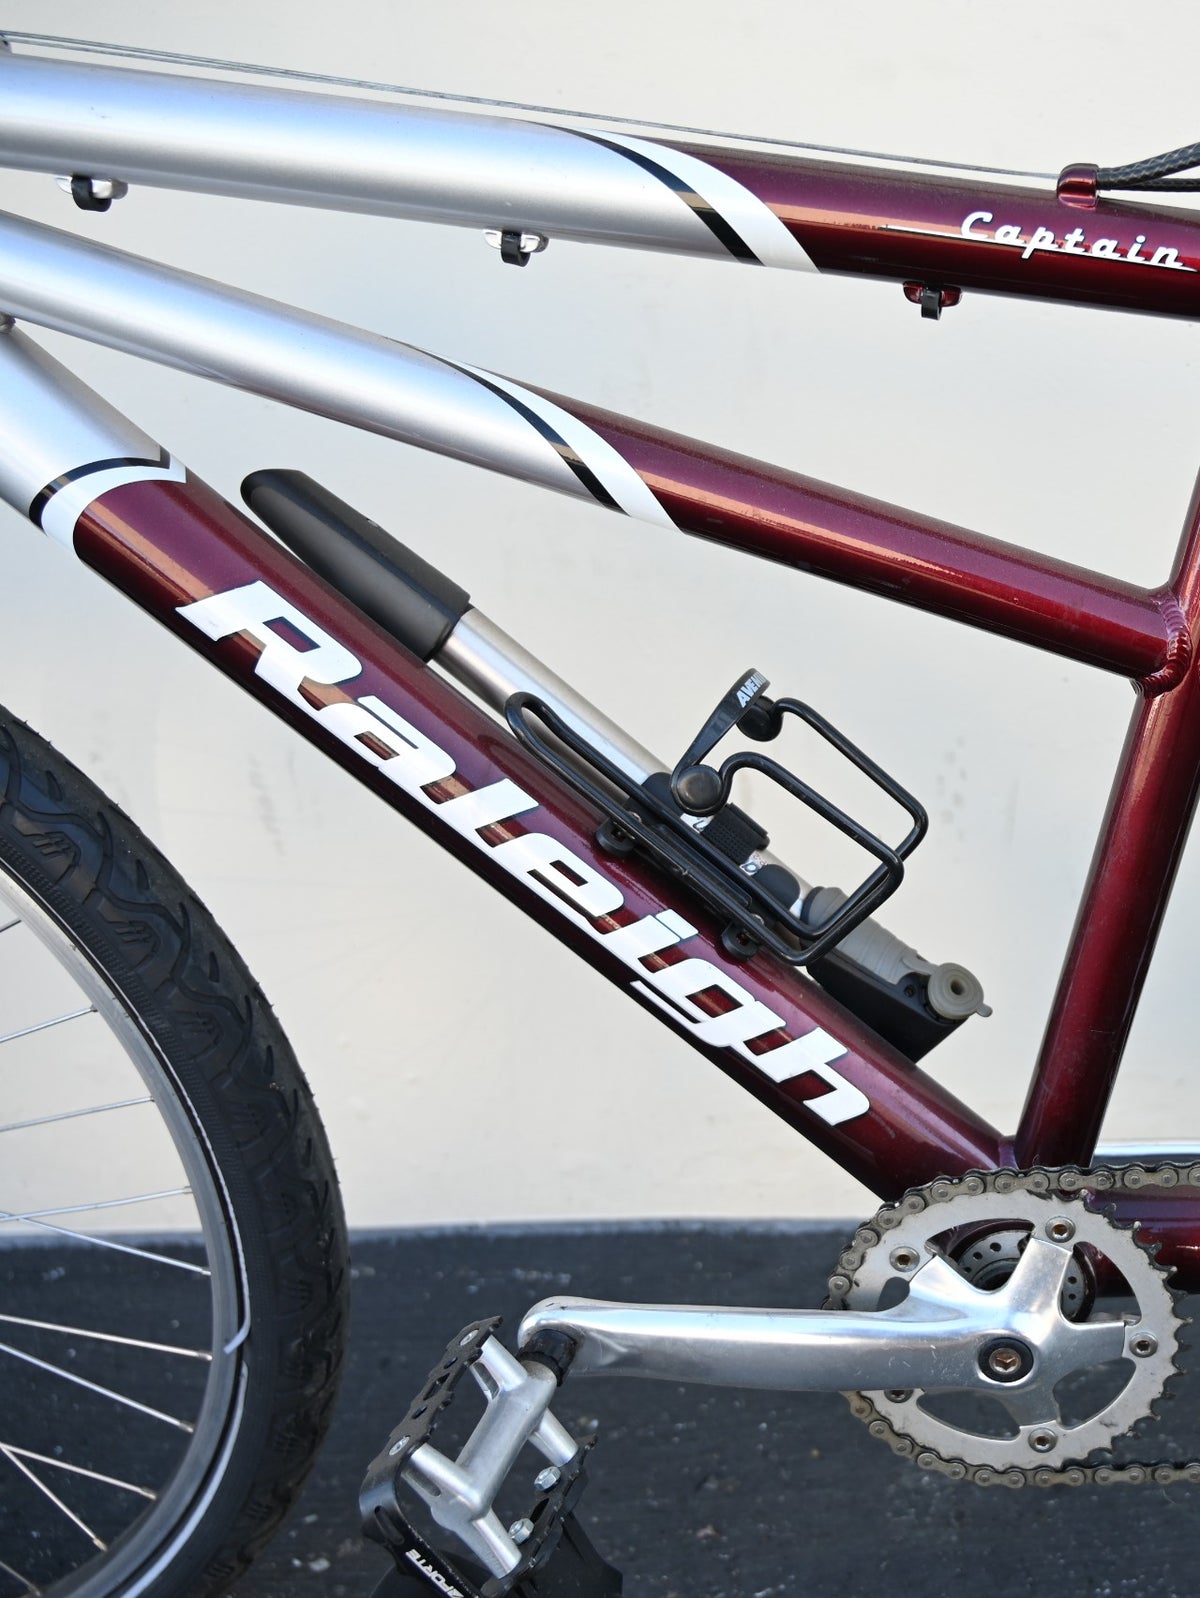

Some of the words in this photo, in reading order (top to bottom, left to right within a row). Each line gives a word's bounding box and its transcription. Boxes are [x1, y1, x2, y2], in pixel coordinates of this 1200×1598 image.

[960, 211, 1184, 268] Captain
[175, 580, 869, 1126] Raleigh
[405, 1549, 455, 1594] FORTE
